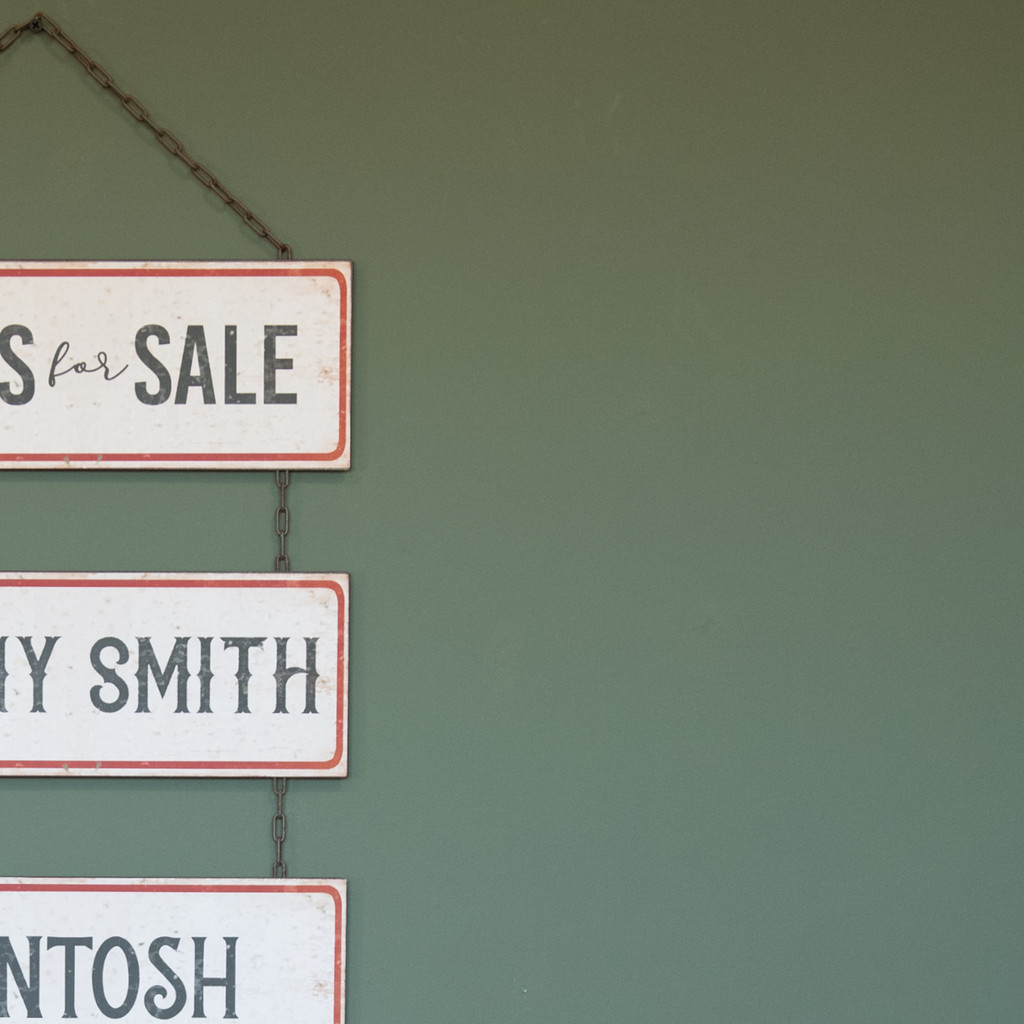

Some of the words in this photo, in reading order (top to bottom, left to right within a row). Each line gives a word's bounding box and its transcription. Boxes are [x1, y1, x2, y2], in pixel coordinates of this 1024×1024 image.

[48, 341, 129, 388] for
[134, 324, 299, 406] SALE
[89, 636, 321, 714] SMITH
